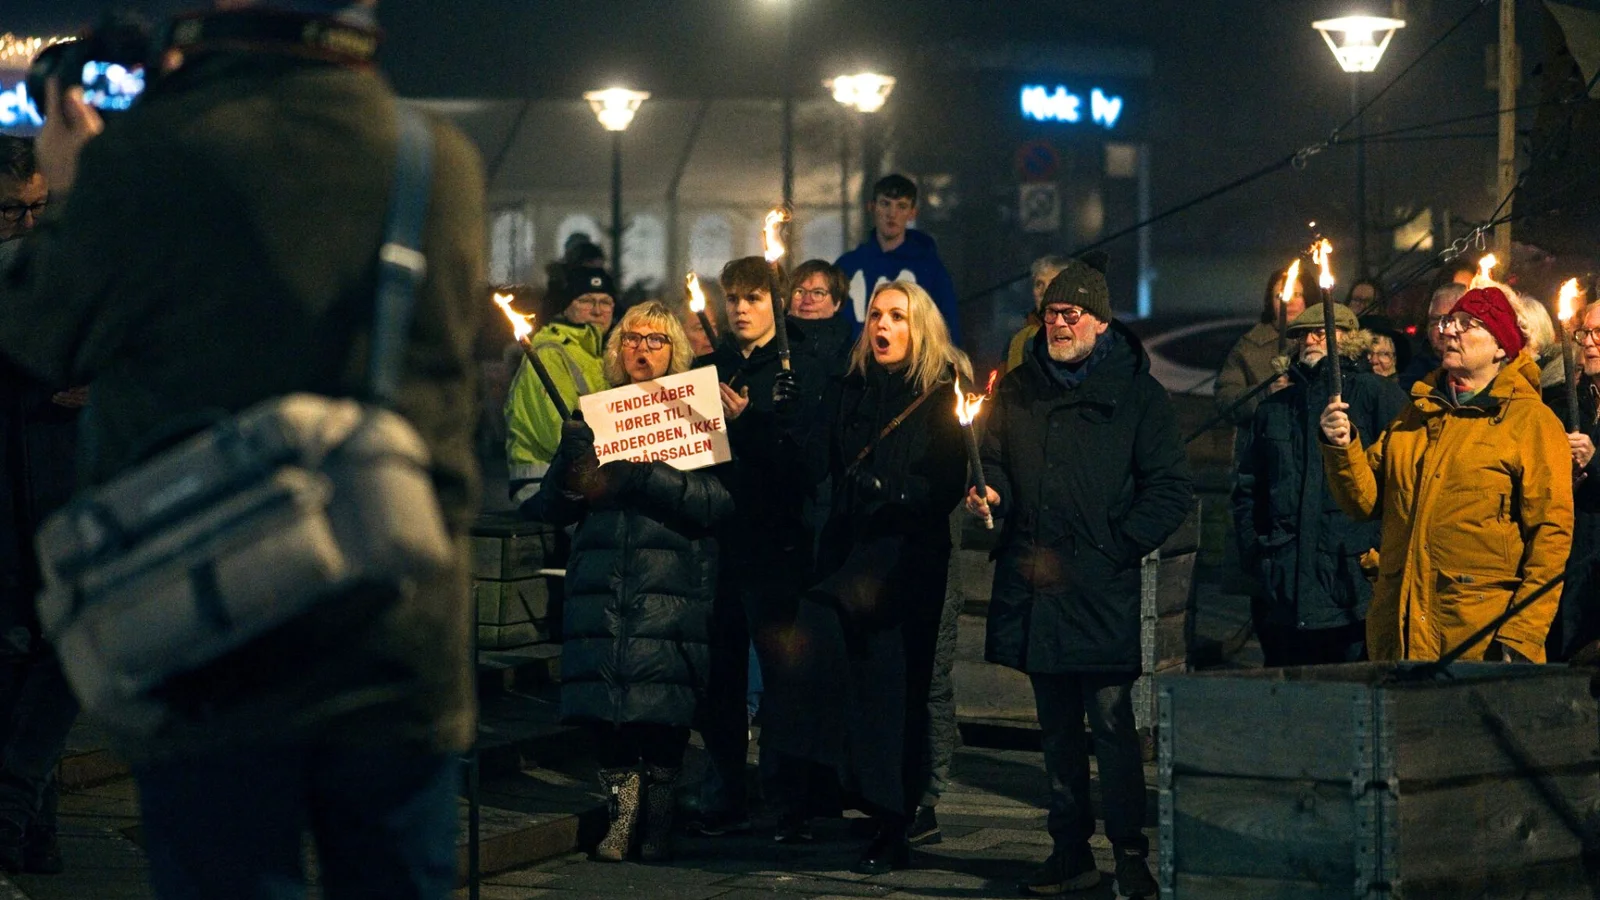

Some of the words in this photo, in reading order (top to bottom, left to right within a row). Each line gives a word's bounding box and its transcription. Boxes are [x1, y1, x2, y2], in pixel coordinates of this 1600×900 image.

[605, 384, 695, 414] VENDEKÅBER
[615, 412, 660, 432] HØRER
[664, 406, 685, 421] TIL
[688, 404, 693, 416] I
[595, 427, 687, 457] GARDEROBEN,
[690, 417, 721, 435] IKKE
